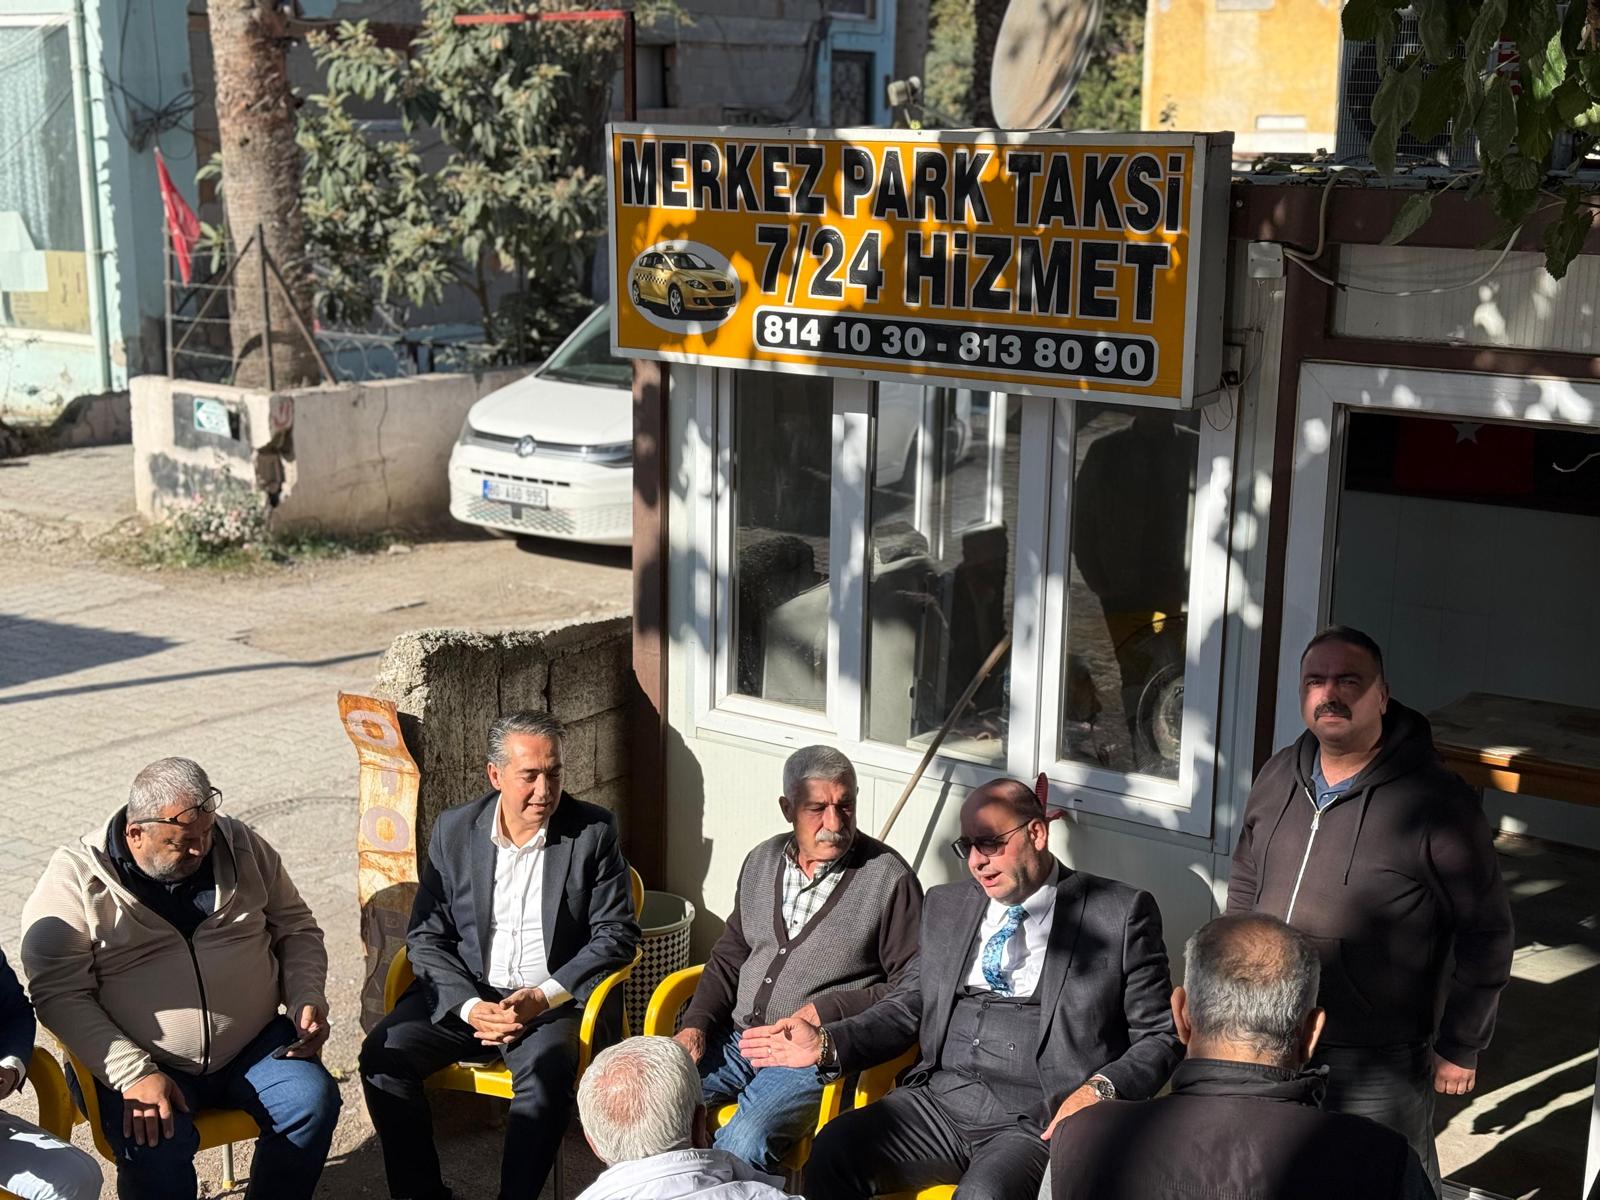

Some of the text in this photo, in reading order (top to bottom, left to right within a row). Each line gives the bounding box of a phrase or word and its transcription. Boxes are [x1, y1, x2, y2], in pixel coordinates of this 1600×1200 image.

[621, 139, 827, 215] MERKEZ
[841, 147, 992, 225] PARK
[756, 223, 884, 304] 7/24
[763, 314, 820, 347] 814
[834, 321, 870, 351] 10
[881, 323, 925, 354] 30
[959, 331, 1022, 364] 813
[1033, 337, 1083, 370] 80
[1094, 341, 1146, 376] 90
